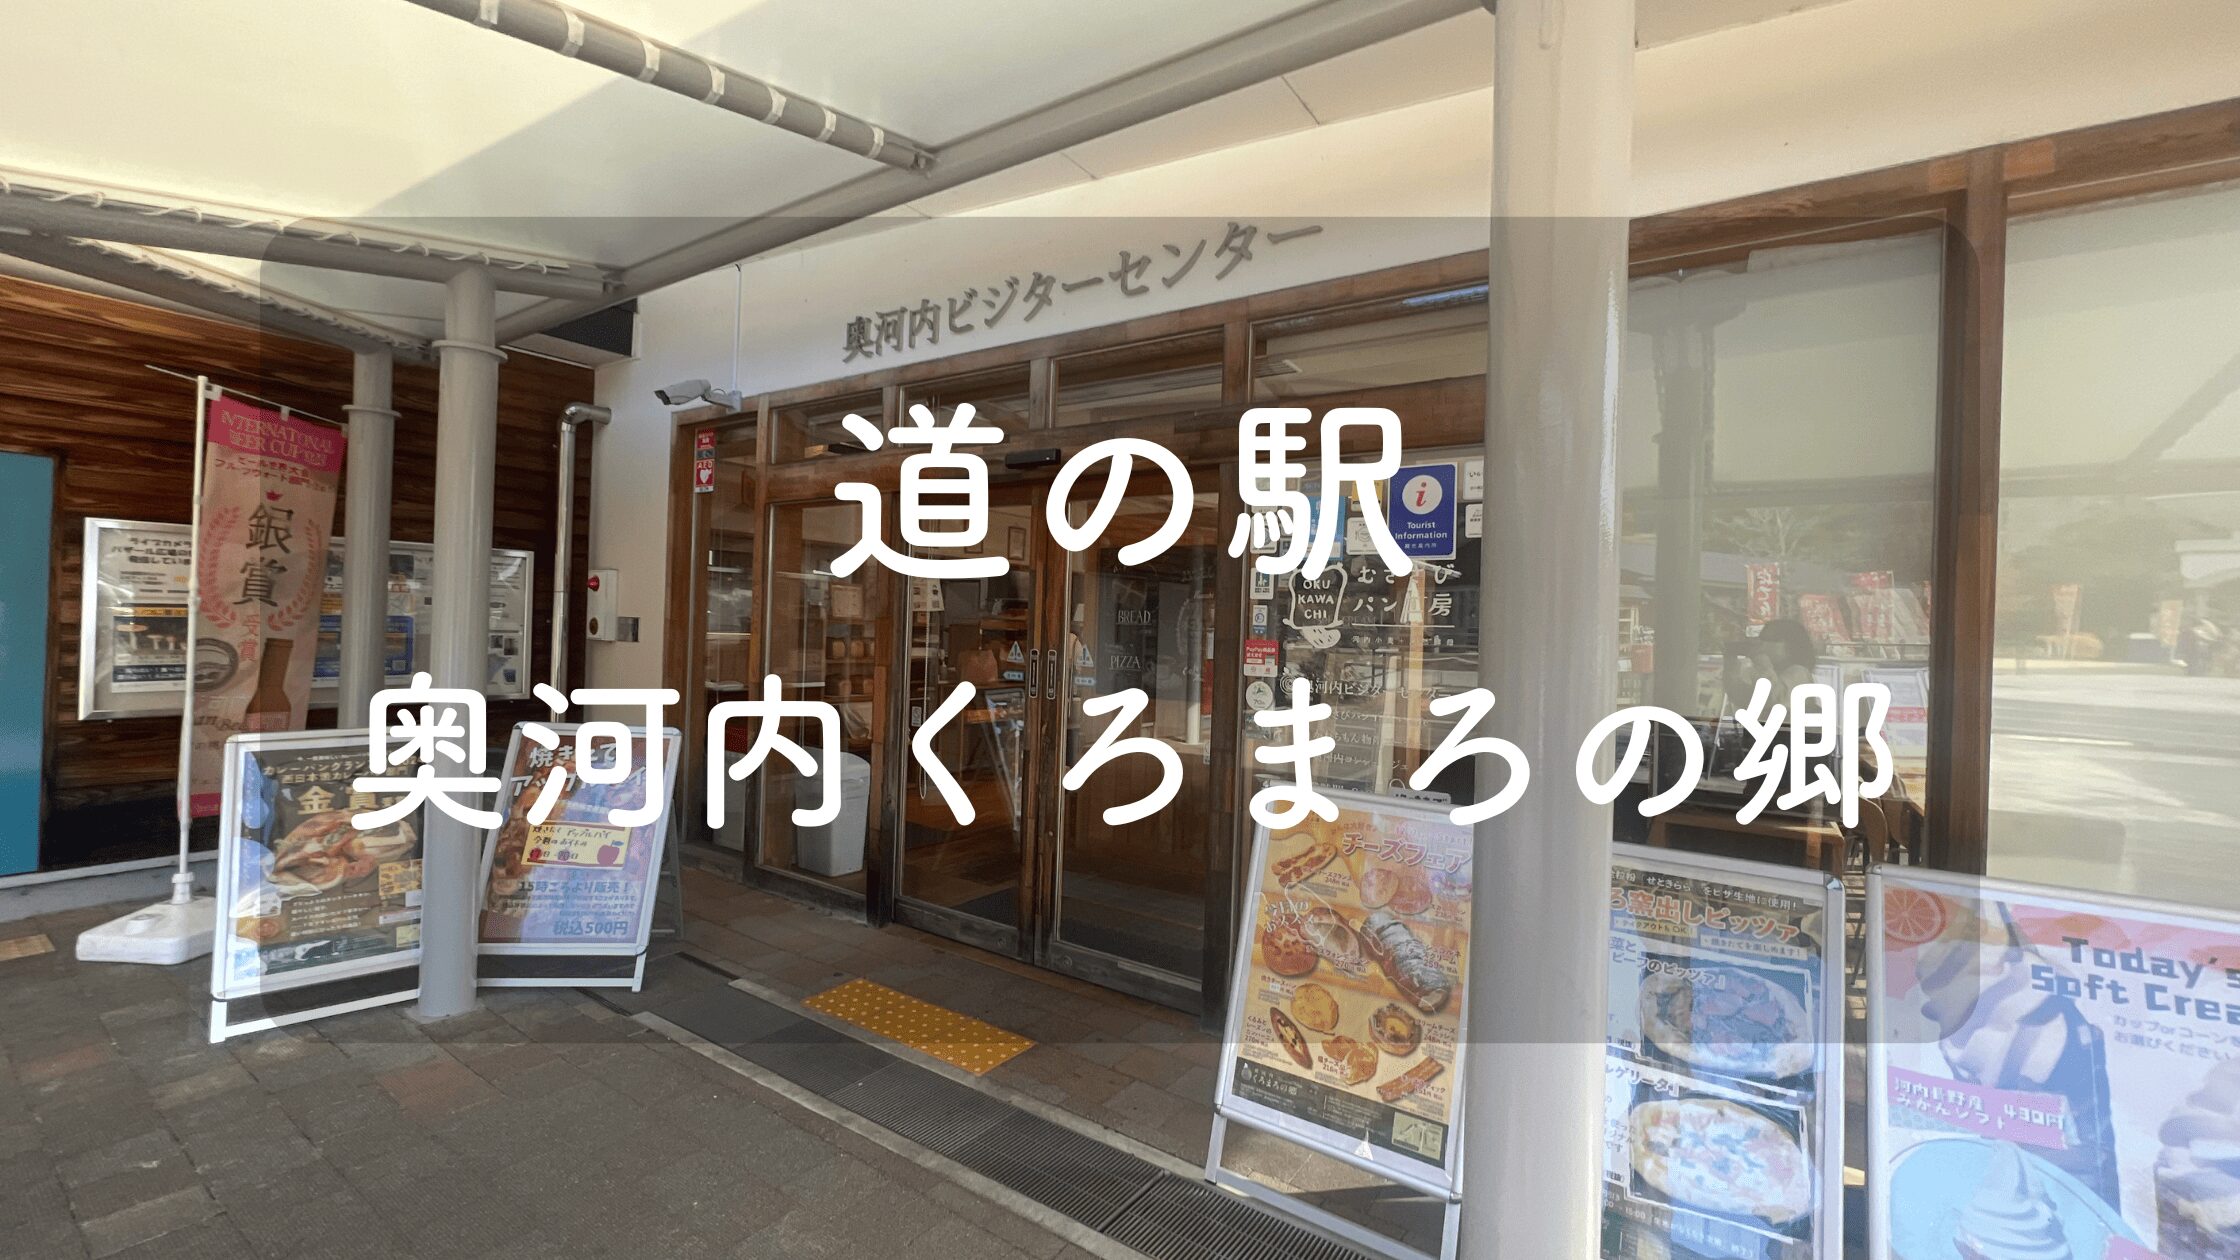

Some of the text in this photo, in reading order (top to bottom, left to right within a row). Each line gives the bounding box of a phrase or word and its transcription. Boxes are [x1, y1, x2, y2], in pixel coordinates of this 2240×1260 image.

[842, 220, 1324, 364] 奥河内ビジターセンター
[1395, 532, 1448, 540] Information
[1407, 521, 1436, 530] Tourist
[234, 503, 294, 607] 銀賞
[1303, 578, 1331, 590] OKU
[1297, 594, 1334, 605] KAWA
[1352, 592, 1453, 617] パン房
[1117, 609, 1151, 624] BREAD
[1304, 608, 1327, 620] CHI
[240, 613, 261, 662] 受賞
[1110, 654, 1141, 669] PIZZA
[1341, 831, 1473, 874] チーズフェア
[552, 920, 629, 937] 税込500円
[2031, 963, 2130, 1005] Soft
[2113, 1030, 2232, 1062] お選びください
[1894, 1077, 2065, 1131] 河内長野産 430円
[1896, 1093, 2006, 1130] みかんソフト
